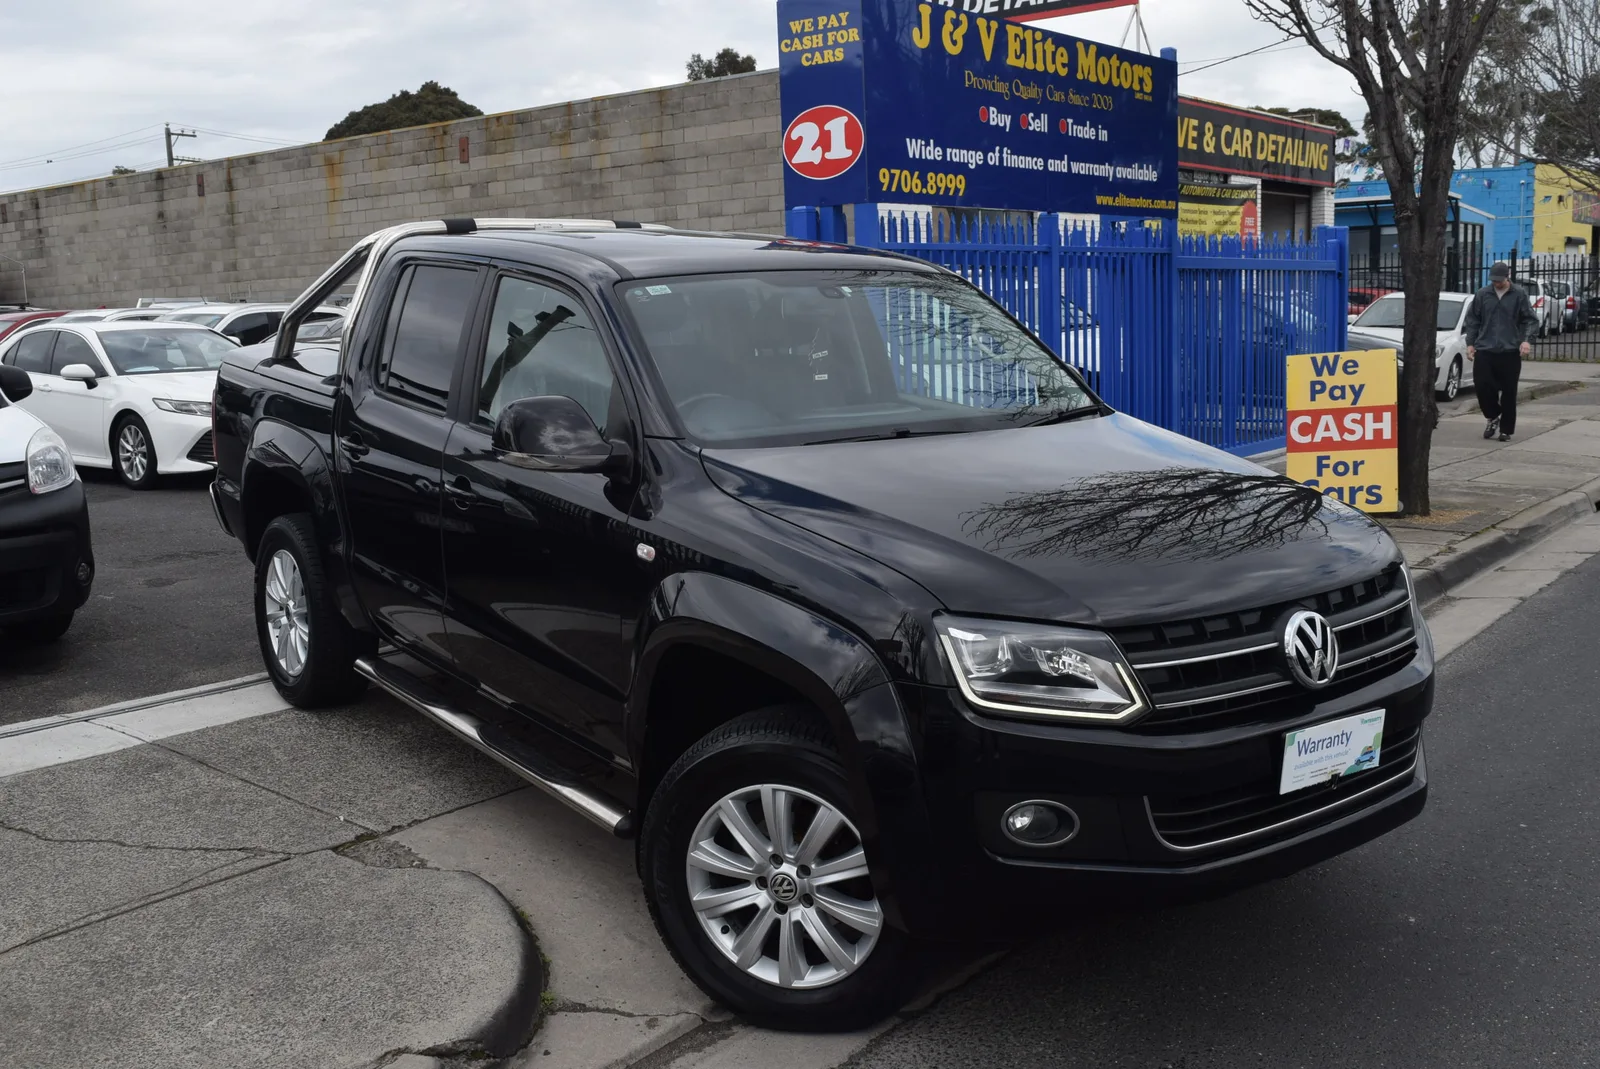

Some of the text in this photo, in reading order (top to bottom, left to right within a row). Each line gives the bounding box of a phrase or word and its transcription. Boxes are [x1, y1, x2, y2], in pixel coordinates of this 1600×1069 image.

[789, 12, 849, 34] WE PAY
[780, 28, 860, 53] CASH FOR
[912, 3, 1153, 93] J & V Elite Motors
[801, 47, 844, 67] CARS
[964, 70, 1010, 100] Providing
[1012, 79, 1043, 104] Quality
[1046, 84, 1066, 103] Cars
[1067, 88, 1090, 107] Since
[1091, 93, 1113, 112] 2003
[989, 106, 1108, 142] Buy Sell Trade in
[790, 115, 853, 165] 21
[1203, 121, 1216, 154] &
[1220, 124, 1253, 159] CAR
[1256, 131, 1329, 171] DETAILING
[905, 137, 1158, 182] Wide range of finance and warranty available
[878, 167, 966, 197] 9706.8999
[1095, 192, 1177, 210] www.elitemotors.com.au
[1310, 354, 1359, 377] We
[1309, 380, 1366, 406] Pay
[1289, 411, 1392, 444] CASH
[1316, 455, 1365, 477] For
[1297, 729, 1353, 758] Warranty
